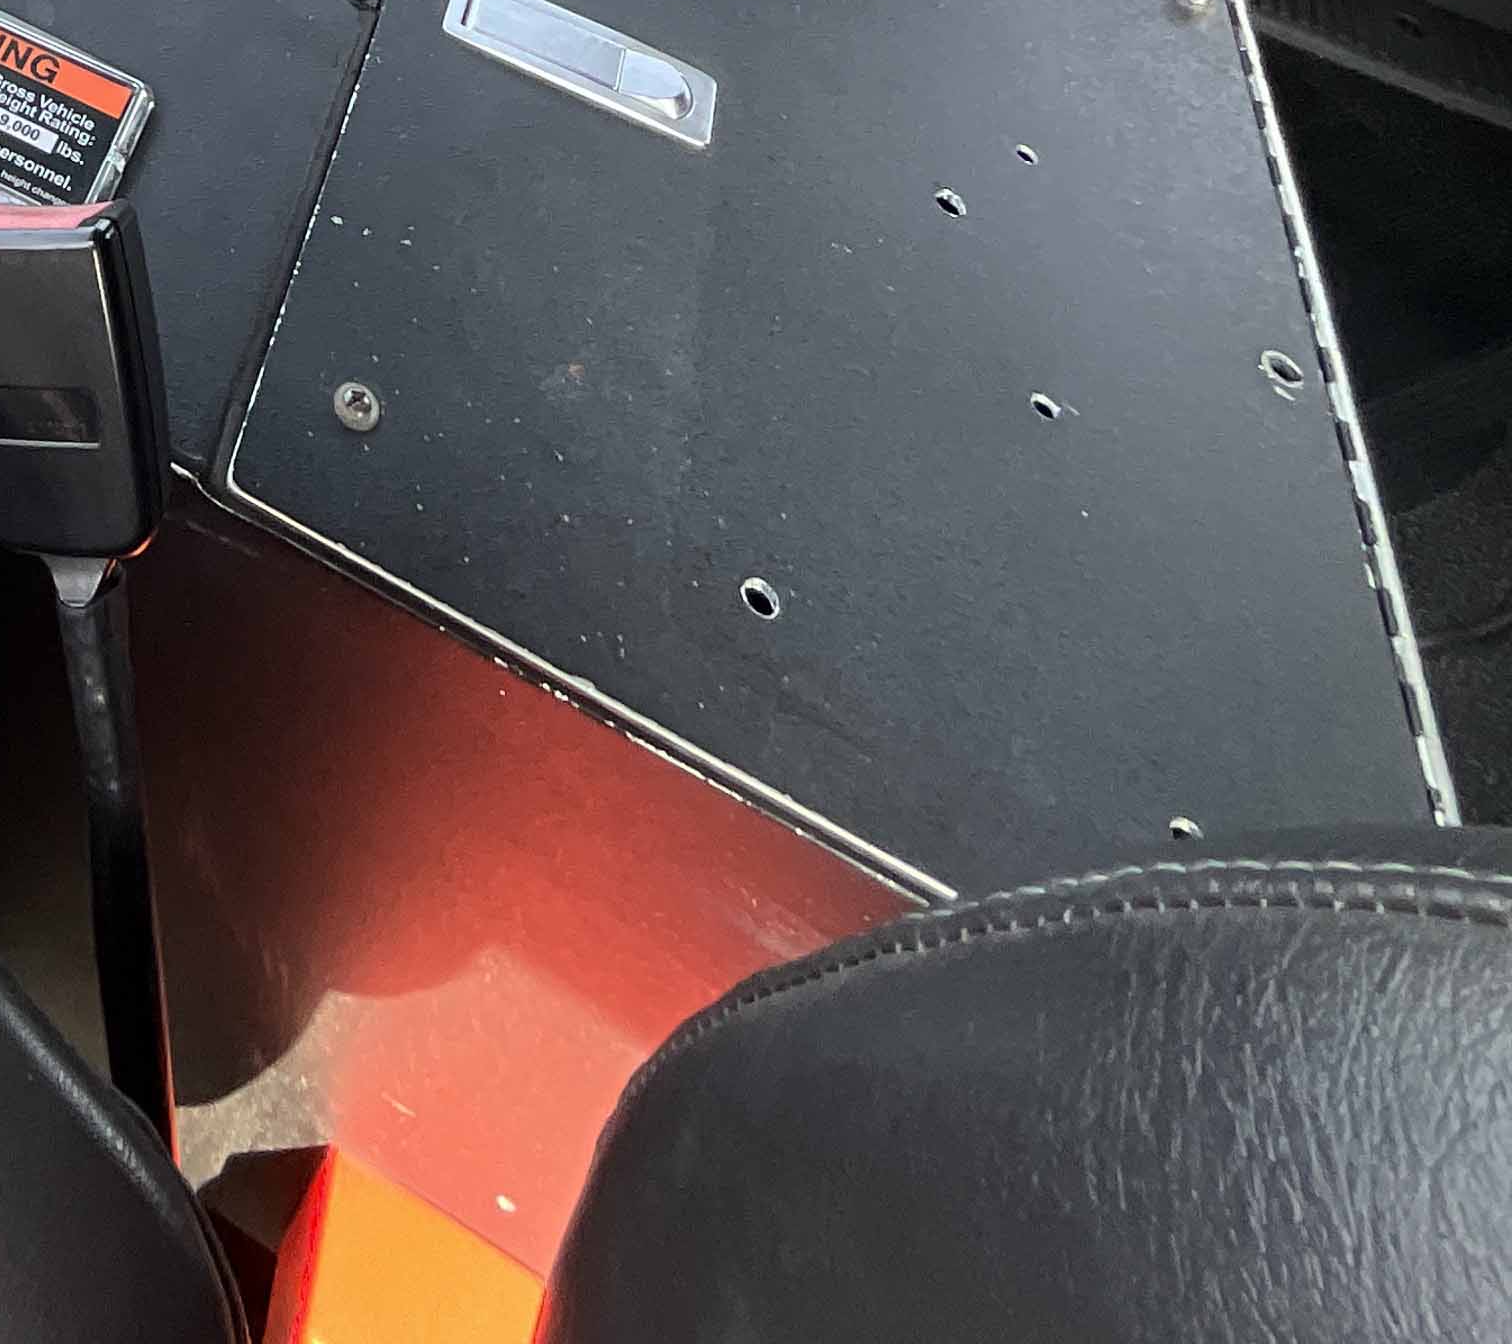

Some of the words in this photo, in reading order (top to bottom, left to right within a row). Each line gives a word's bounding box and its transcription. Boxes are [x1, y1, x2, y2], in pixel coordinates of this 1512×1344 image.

[40, 94, 96, 131] Vehicle
[38, 111, 97, 147] Rating:
[56, 140, 85, 166] lbs.
[0, 169, 31, 191] height
